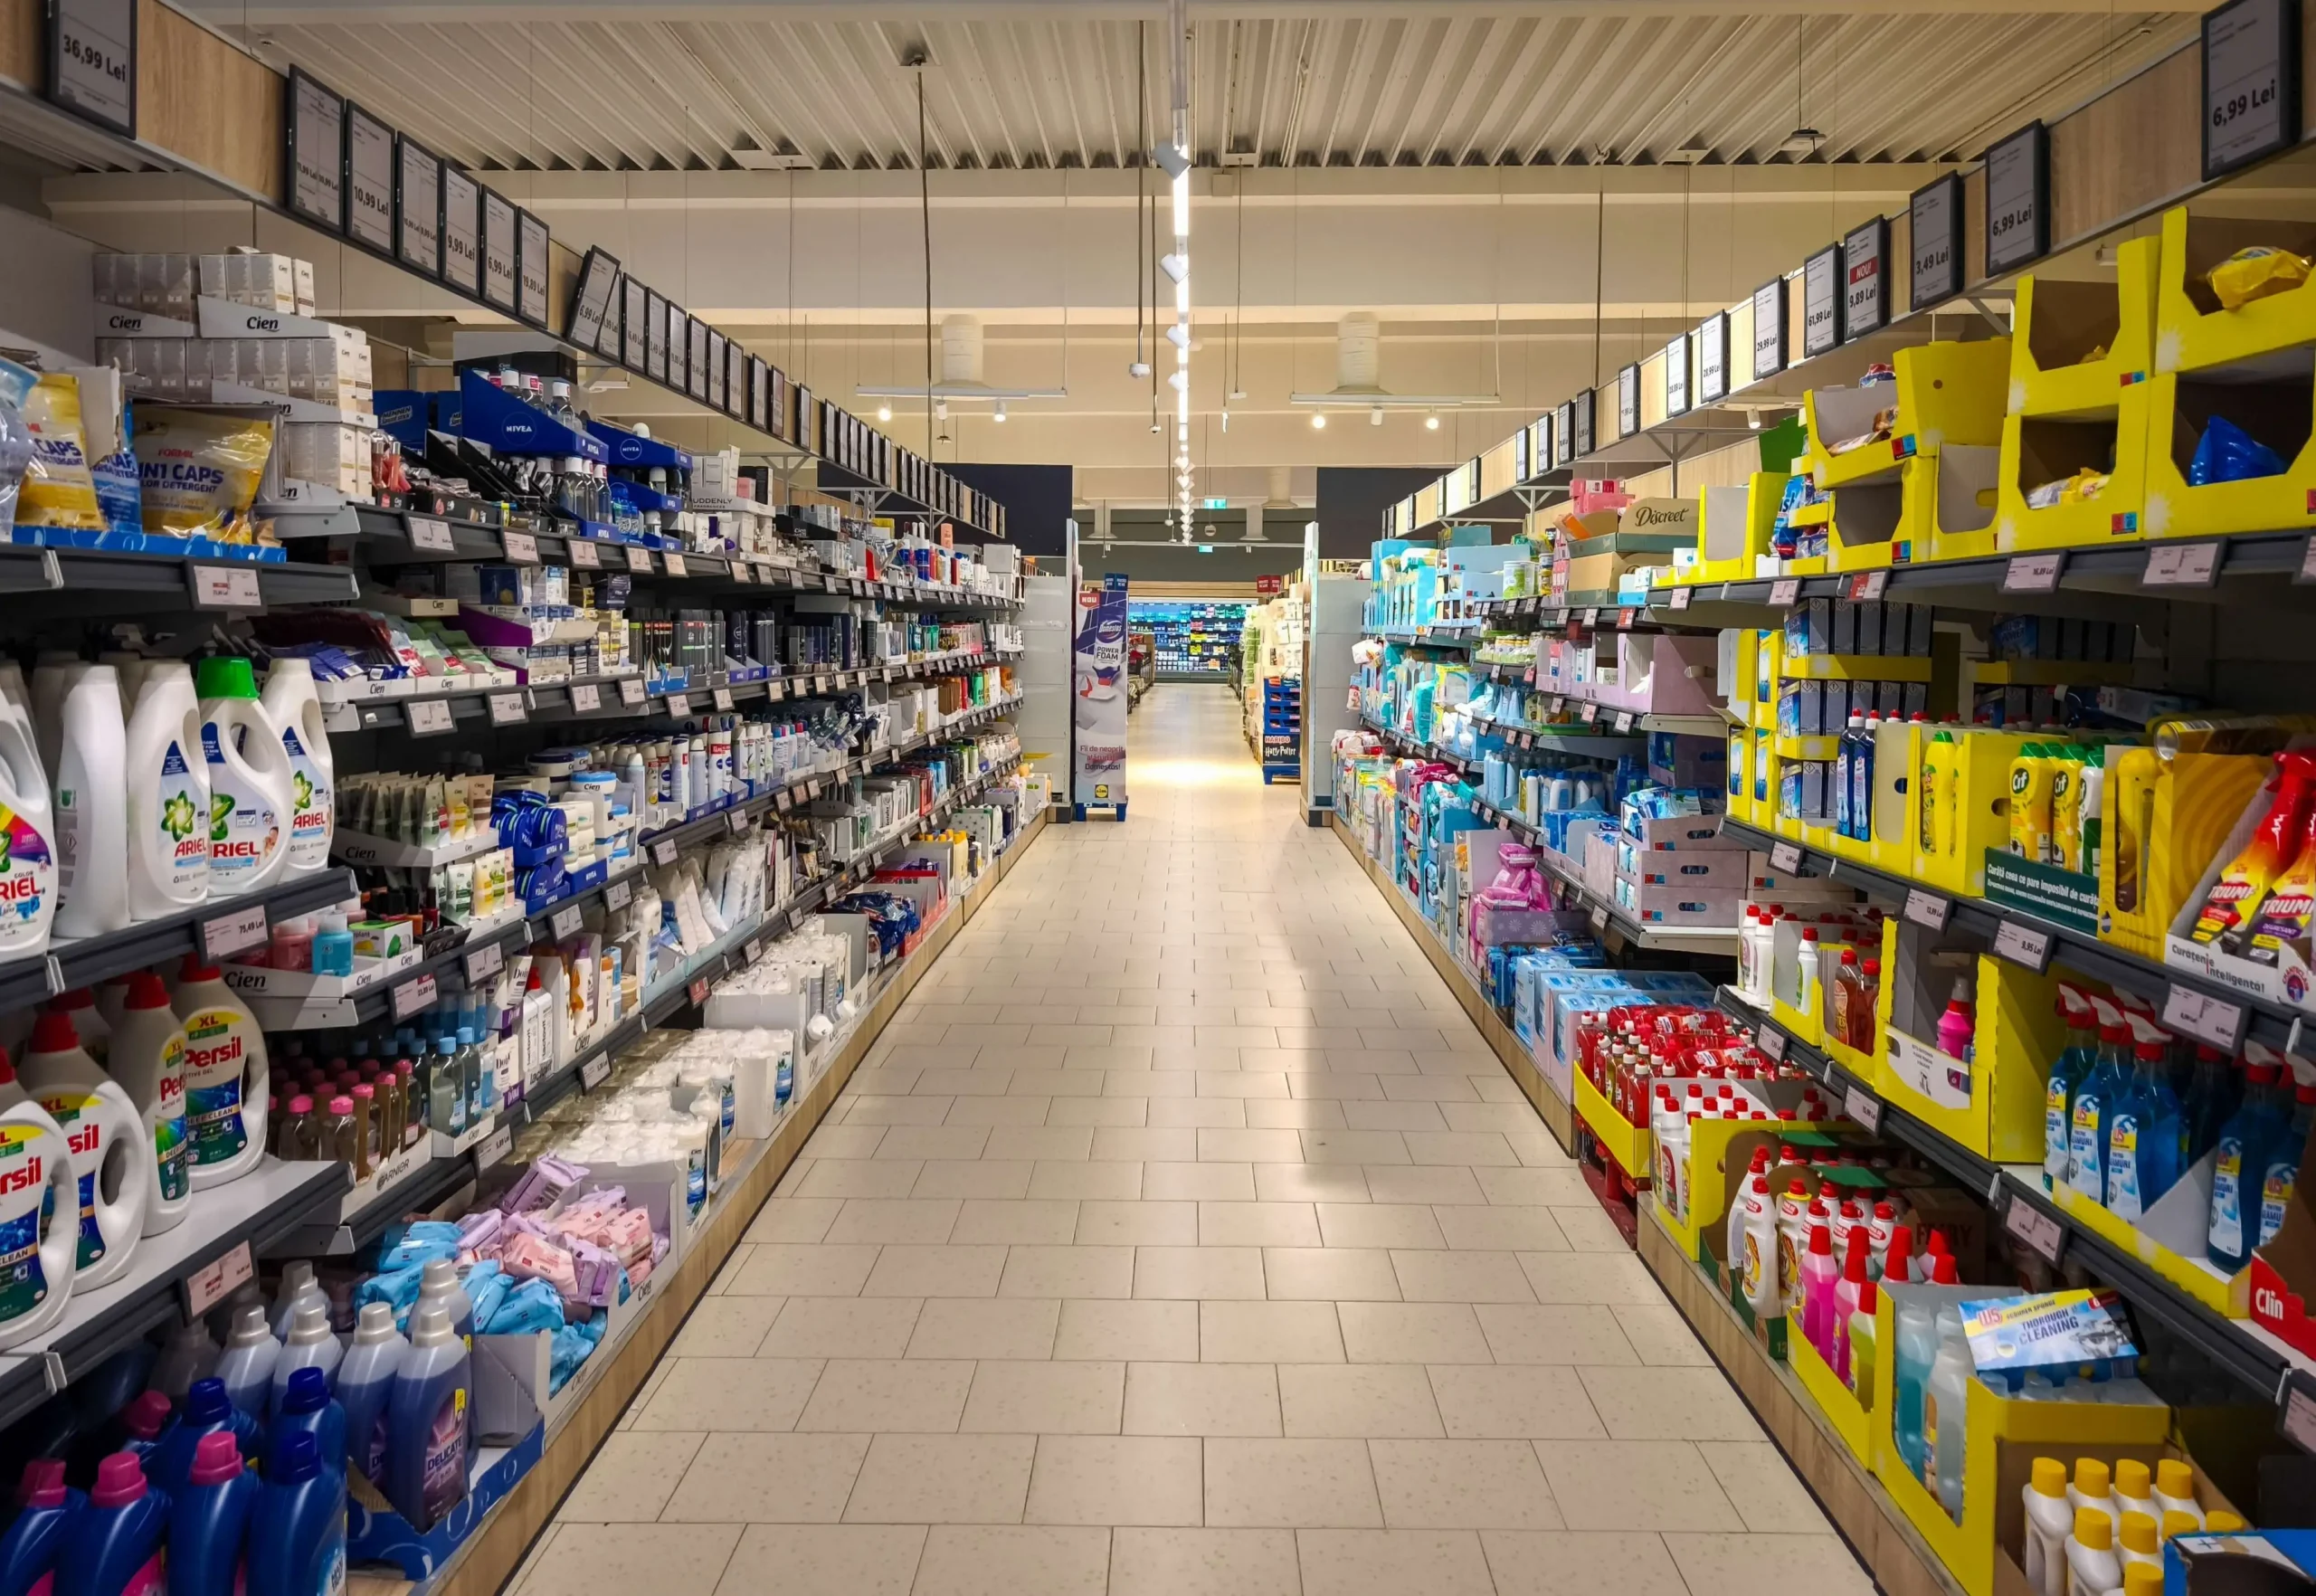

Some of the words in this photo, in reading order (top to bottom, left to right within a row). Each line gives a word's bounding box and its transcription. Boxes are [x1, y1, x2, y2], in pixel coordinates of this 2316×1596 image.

[63, 34, 102, 70] 36,99
[106, 57, 126, 82] Lei
[2213, 94, 2247, 127] 6,99
[2252, 79, 2275, 109] Lei
[354, 185, 375, 209] 10,99
[377, 198, 389, 216] Lei
[1992, 214, 2014, 236] 6,99
[2017, 204, 2032, 225] Lei
[447, 234, 464, 254] 9,99
[465, 244, 475, 261] Lei
[488, 256, 502, 275] 6,99
[503, 265, 513, 280] Lei
[1916, 254, 1934, 275] 3,49
[1936, 246, 1949, 266] Lei
[1856, 261, 1872, 280] NOU!
[537, 283, 546, 297] Lei
[1849, 290, 1864, 309] 9,89
[1865, 283, 1876, 300] Lei
[593, 312, 603, 326] Lei
[1824, 306, 1832, 320] Lei
[109, 316, 142, 332] Cien
[247, 316, 280, 332] Cien
[506, 424, 533, 432] NIVEA
[33, 438, 82, 457] CAPS
[587, 442, 599, 456] NIVEA
[172, 463, 225, 485] CAPS
[162, 480, 218, 495] DETERGENT
[1635, 506, 1690, 527] Discreet
[1096, 646, 1119, 654] POWER
[1096, 651, 1118, 661] FOAM
[369, 683, 384, 695] Cien
[1265, 736, 1291, 744] HARIBO
[1085, 763, 1121, 771] Domestos!
[584, 783, 601, 791] Cien
[2012, 772, 2027, 791] Cif
[2055, 774, 2067, 793] Cif
[292, 812, 326, 829] ARIEL
[175, 837, 207, 858] ARIEL
[210, 841, 261, 859] RIEL
[346, 846, 376, 861] Cien
[14, 870, 33, 879] COLOR
[2005, 871, 2019, 884] ceea
[2018, 875, 2026, 885] ce
[2026, 877, 2040, 890] pare
[2040, 879, 2071, 897] imposibil
[2070, 888, 2079, 901] de
[255, 917, 265, 930] Lei
[2034, 945, 2044, 956] Lei
[224, 971, 267, 993] Cien
[356, 973, 372, 985] Cien
[199, 1014, 220, 1028] XL
[184, 1036, 242, 1069] Persil
[204, 1069, 214, 1078] GEL
[209, 1107, 233, 1121] CLEAN
[376, 1159, 410, 1192] GARNIER
[638, 1280, 651, 1301] Cien
[1978, 1307, 2004, 1328] W5
[2007, 1306, 2033, 1319] SCOURER
[2033, 1299, 2055, 1312] SPONGE
[2255, 1287, 2284, 1321] Clin
[2022, 1308, 2069, 1331] THOROUGH
[2018, 1316, 2080, 1345] CLEANING
[427, 1436, 462, 1471] DELICATE
